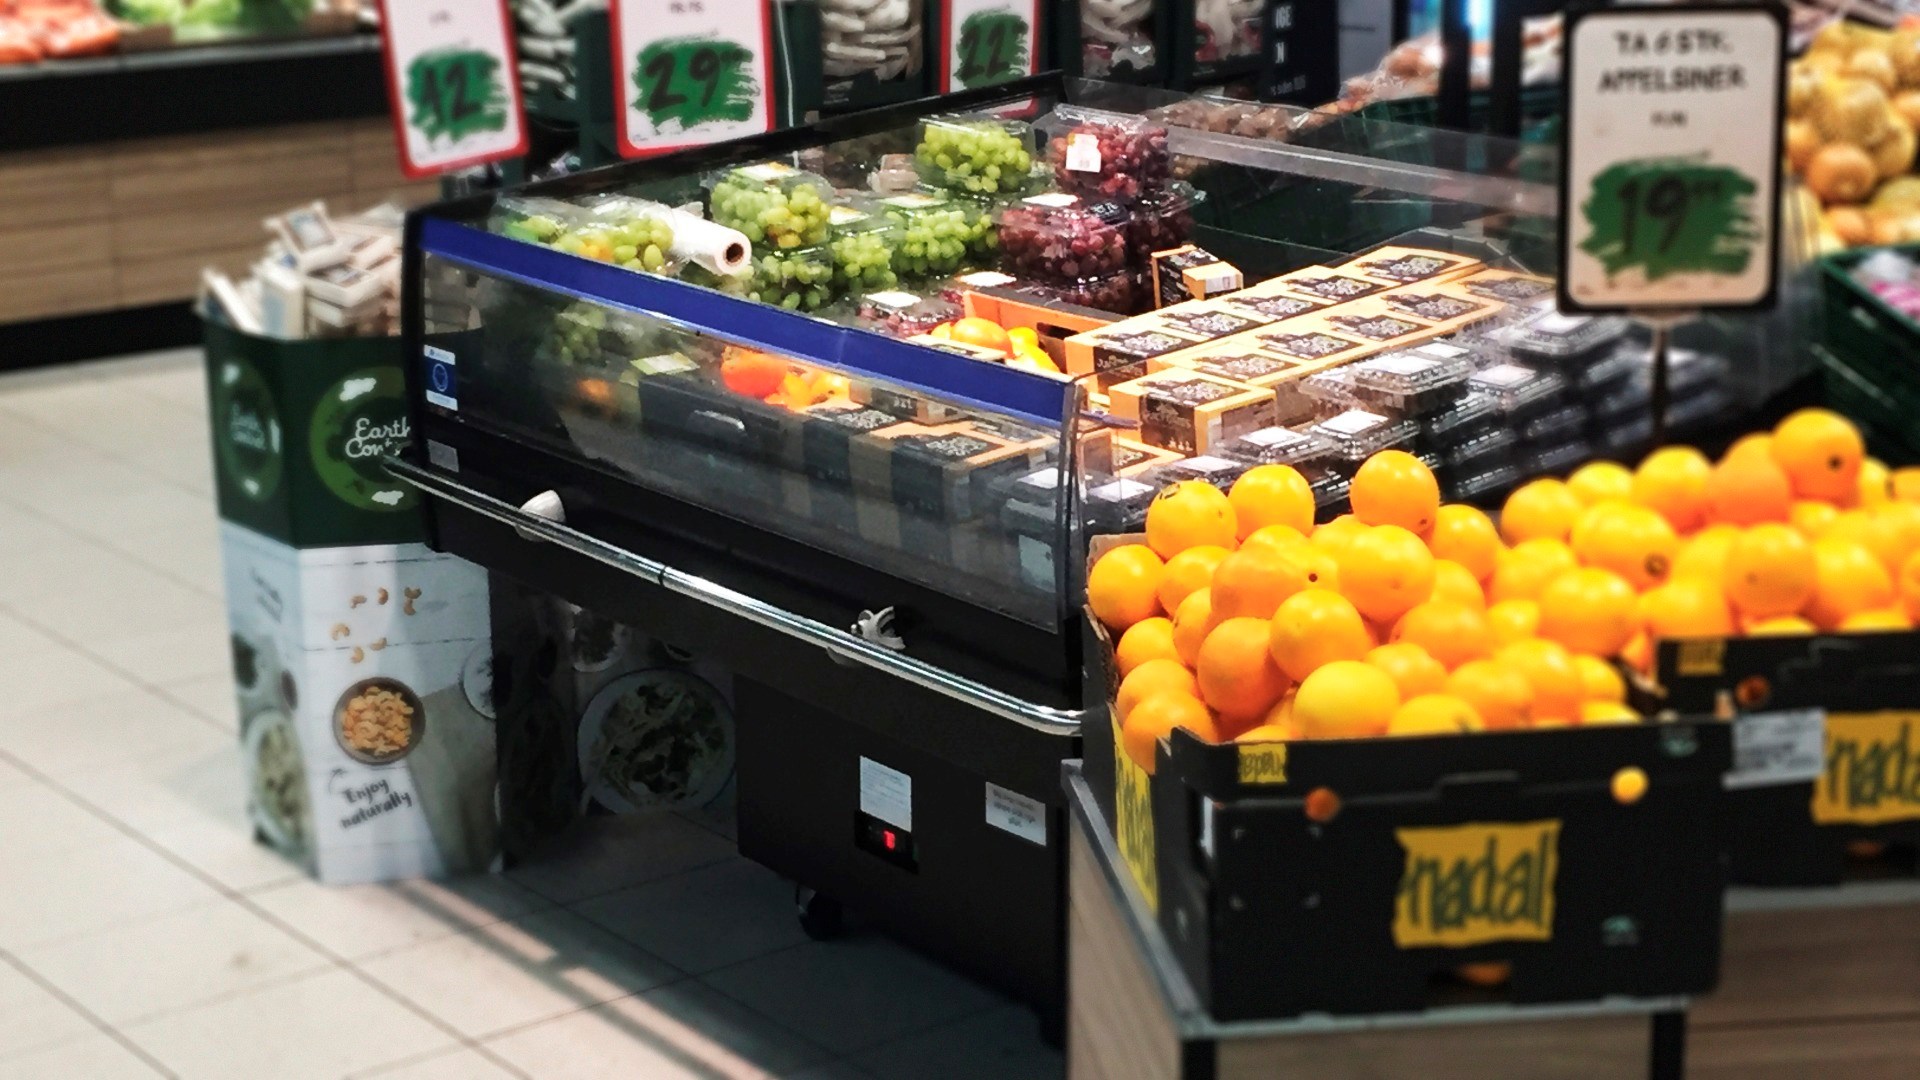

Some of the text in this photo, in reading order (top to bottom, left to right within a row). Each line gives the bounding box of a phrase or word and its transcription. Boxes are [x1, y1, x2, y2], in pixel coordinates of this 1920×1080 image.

[646, 47, 721, 112] 29
[340, 790, 412, 830] naturally
[341, 778, 390, 805] Enjoy
[1399, 832, 1550, 934] nadal
